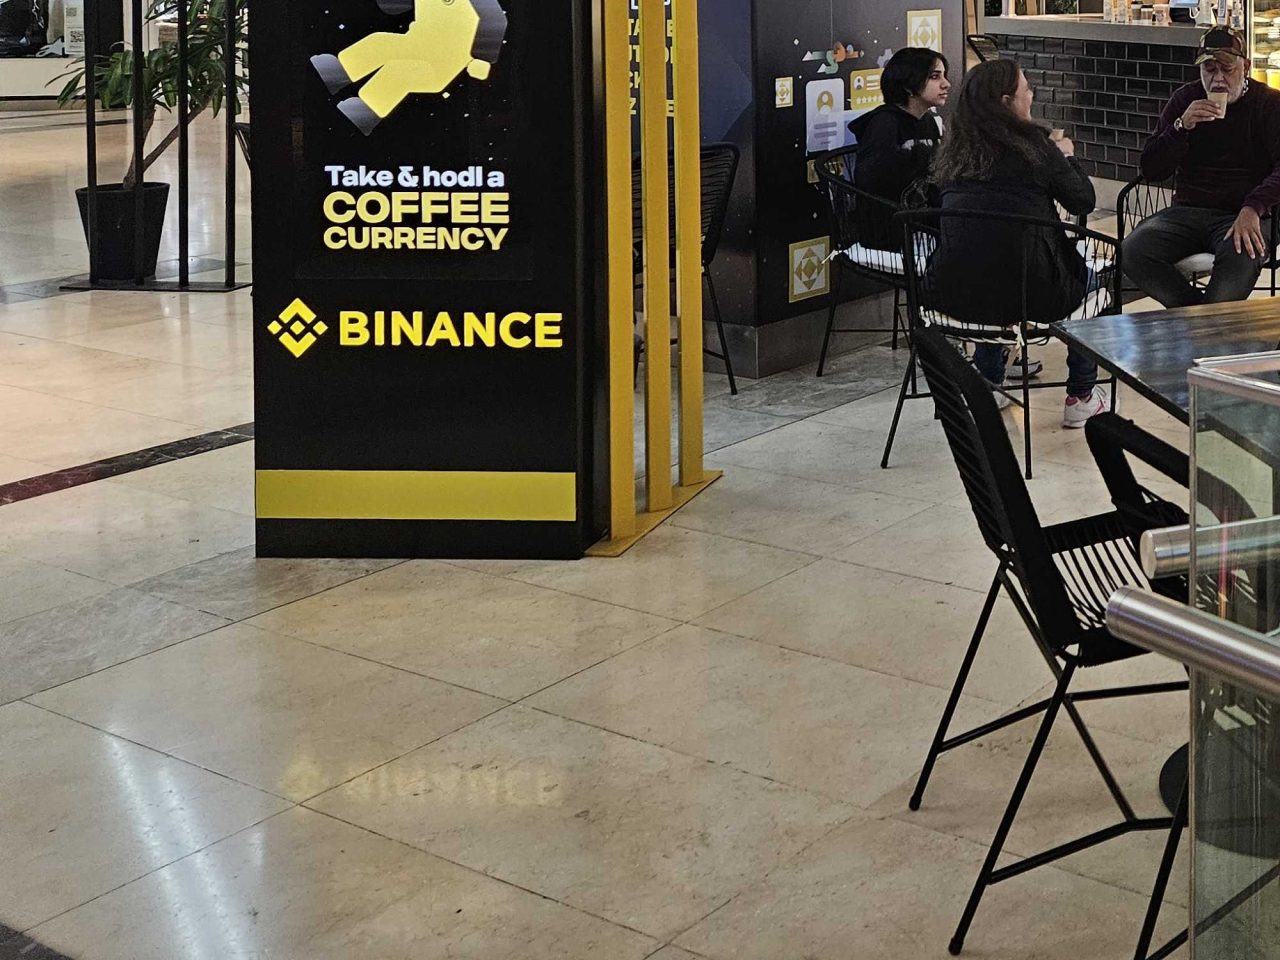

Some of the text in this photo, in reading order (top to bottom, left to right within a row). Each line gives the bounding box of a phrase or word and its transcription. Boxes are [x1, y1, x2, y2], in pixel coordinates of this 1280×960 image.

[324, 165, 505, 188] Take & hodl a
[323, 191, 510, 223] COFFEE
[323, 226, 509, 250] CURRENCY
[339, 310, 563, 348] BINANCE
